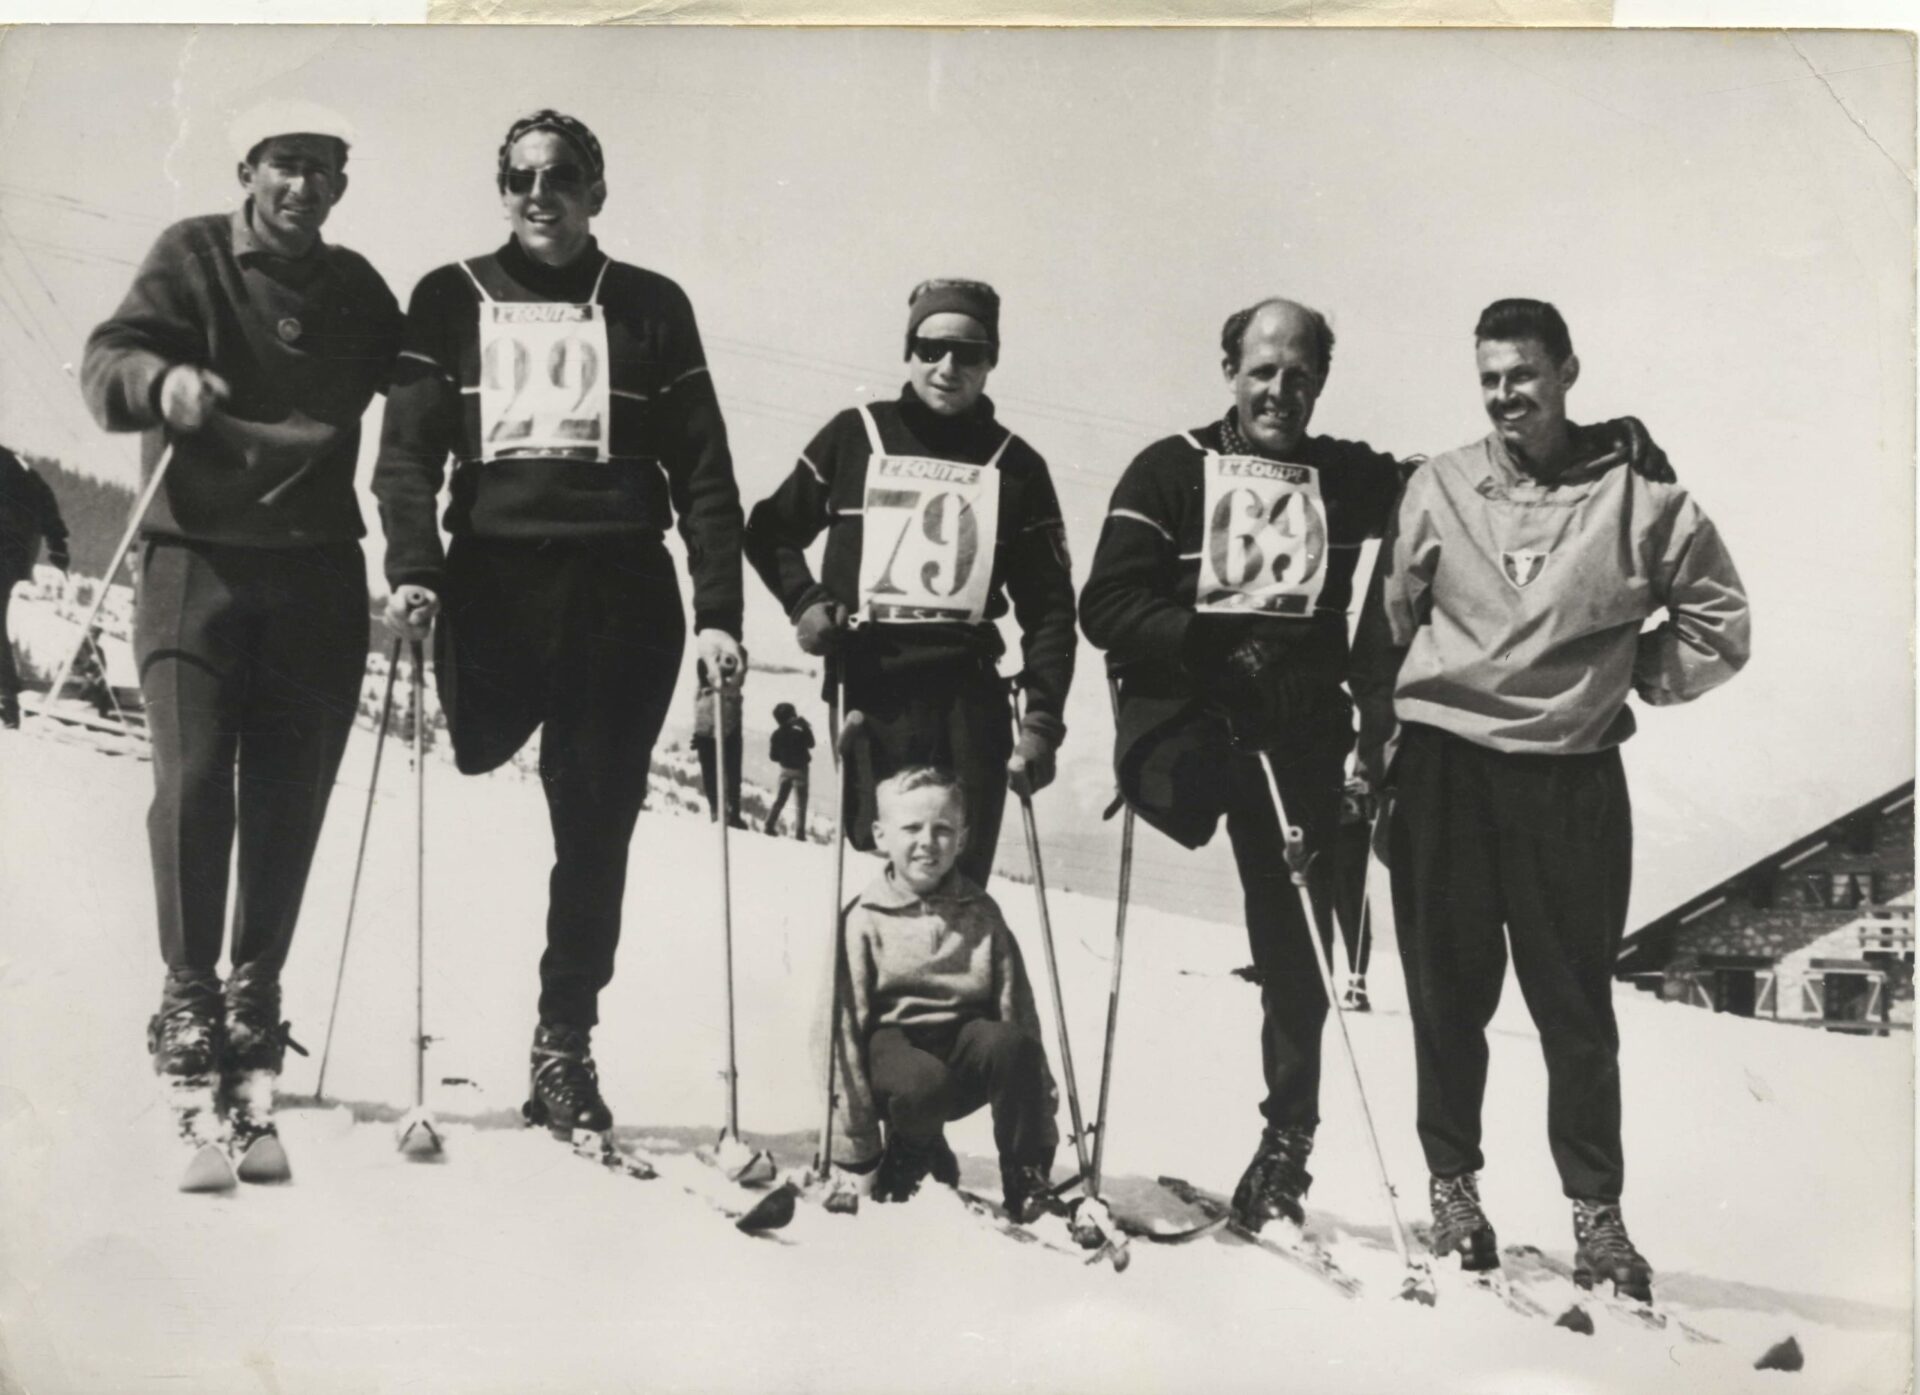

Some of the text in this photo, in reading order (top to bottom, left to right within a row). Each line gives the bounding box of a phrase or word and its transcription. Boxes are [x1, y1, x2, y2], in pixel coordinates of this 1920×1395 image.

[484, 337, 600, 442] 22
[865, 488, 978, 597] 79
[1210, 488, 1325, 587] 69
